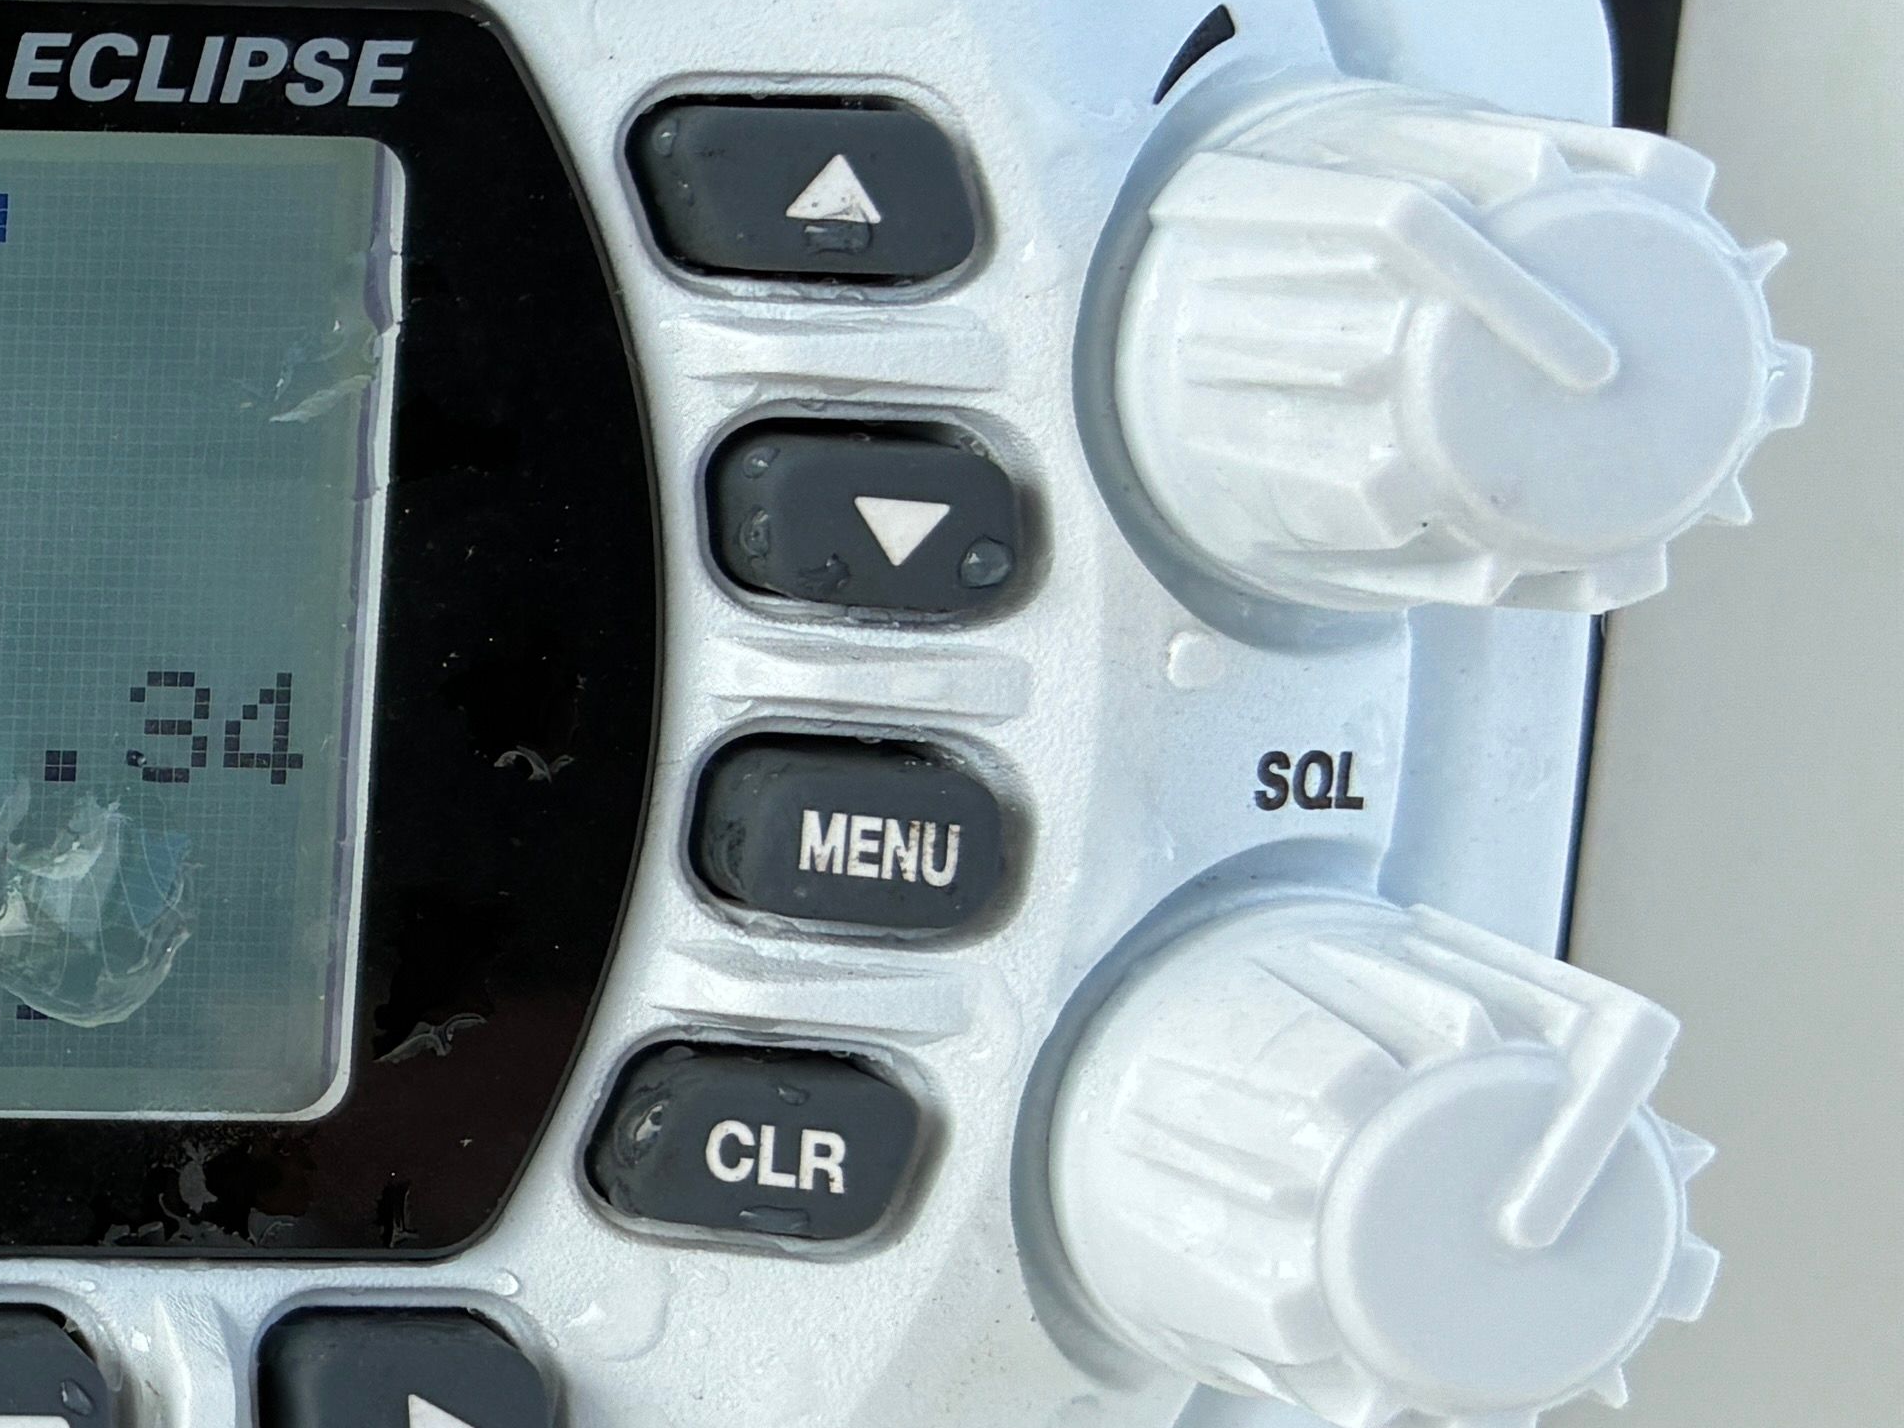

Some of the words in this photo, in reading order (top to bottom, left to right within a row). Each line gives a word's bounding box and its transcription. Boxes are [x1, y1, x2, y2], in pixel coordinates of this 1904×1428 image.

[4, 30, 416, 109] ECLIPSE
[1253, 748, 1366, 813] SQL
[798, 808, 962, 888] MENU
[704, 1119, 847, 1195] CLR
